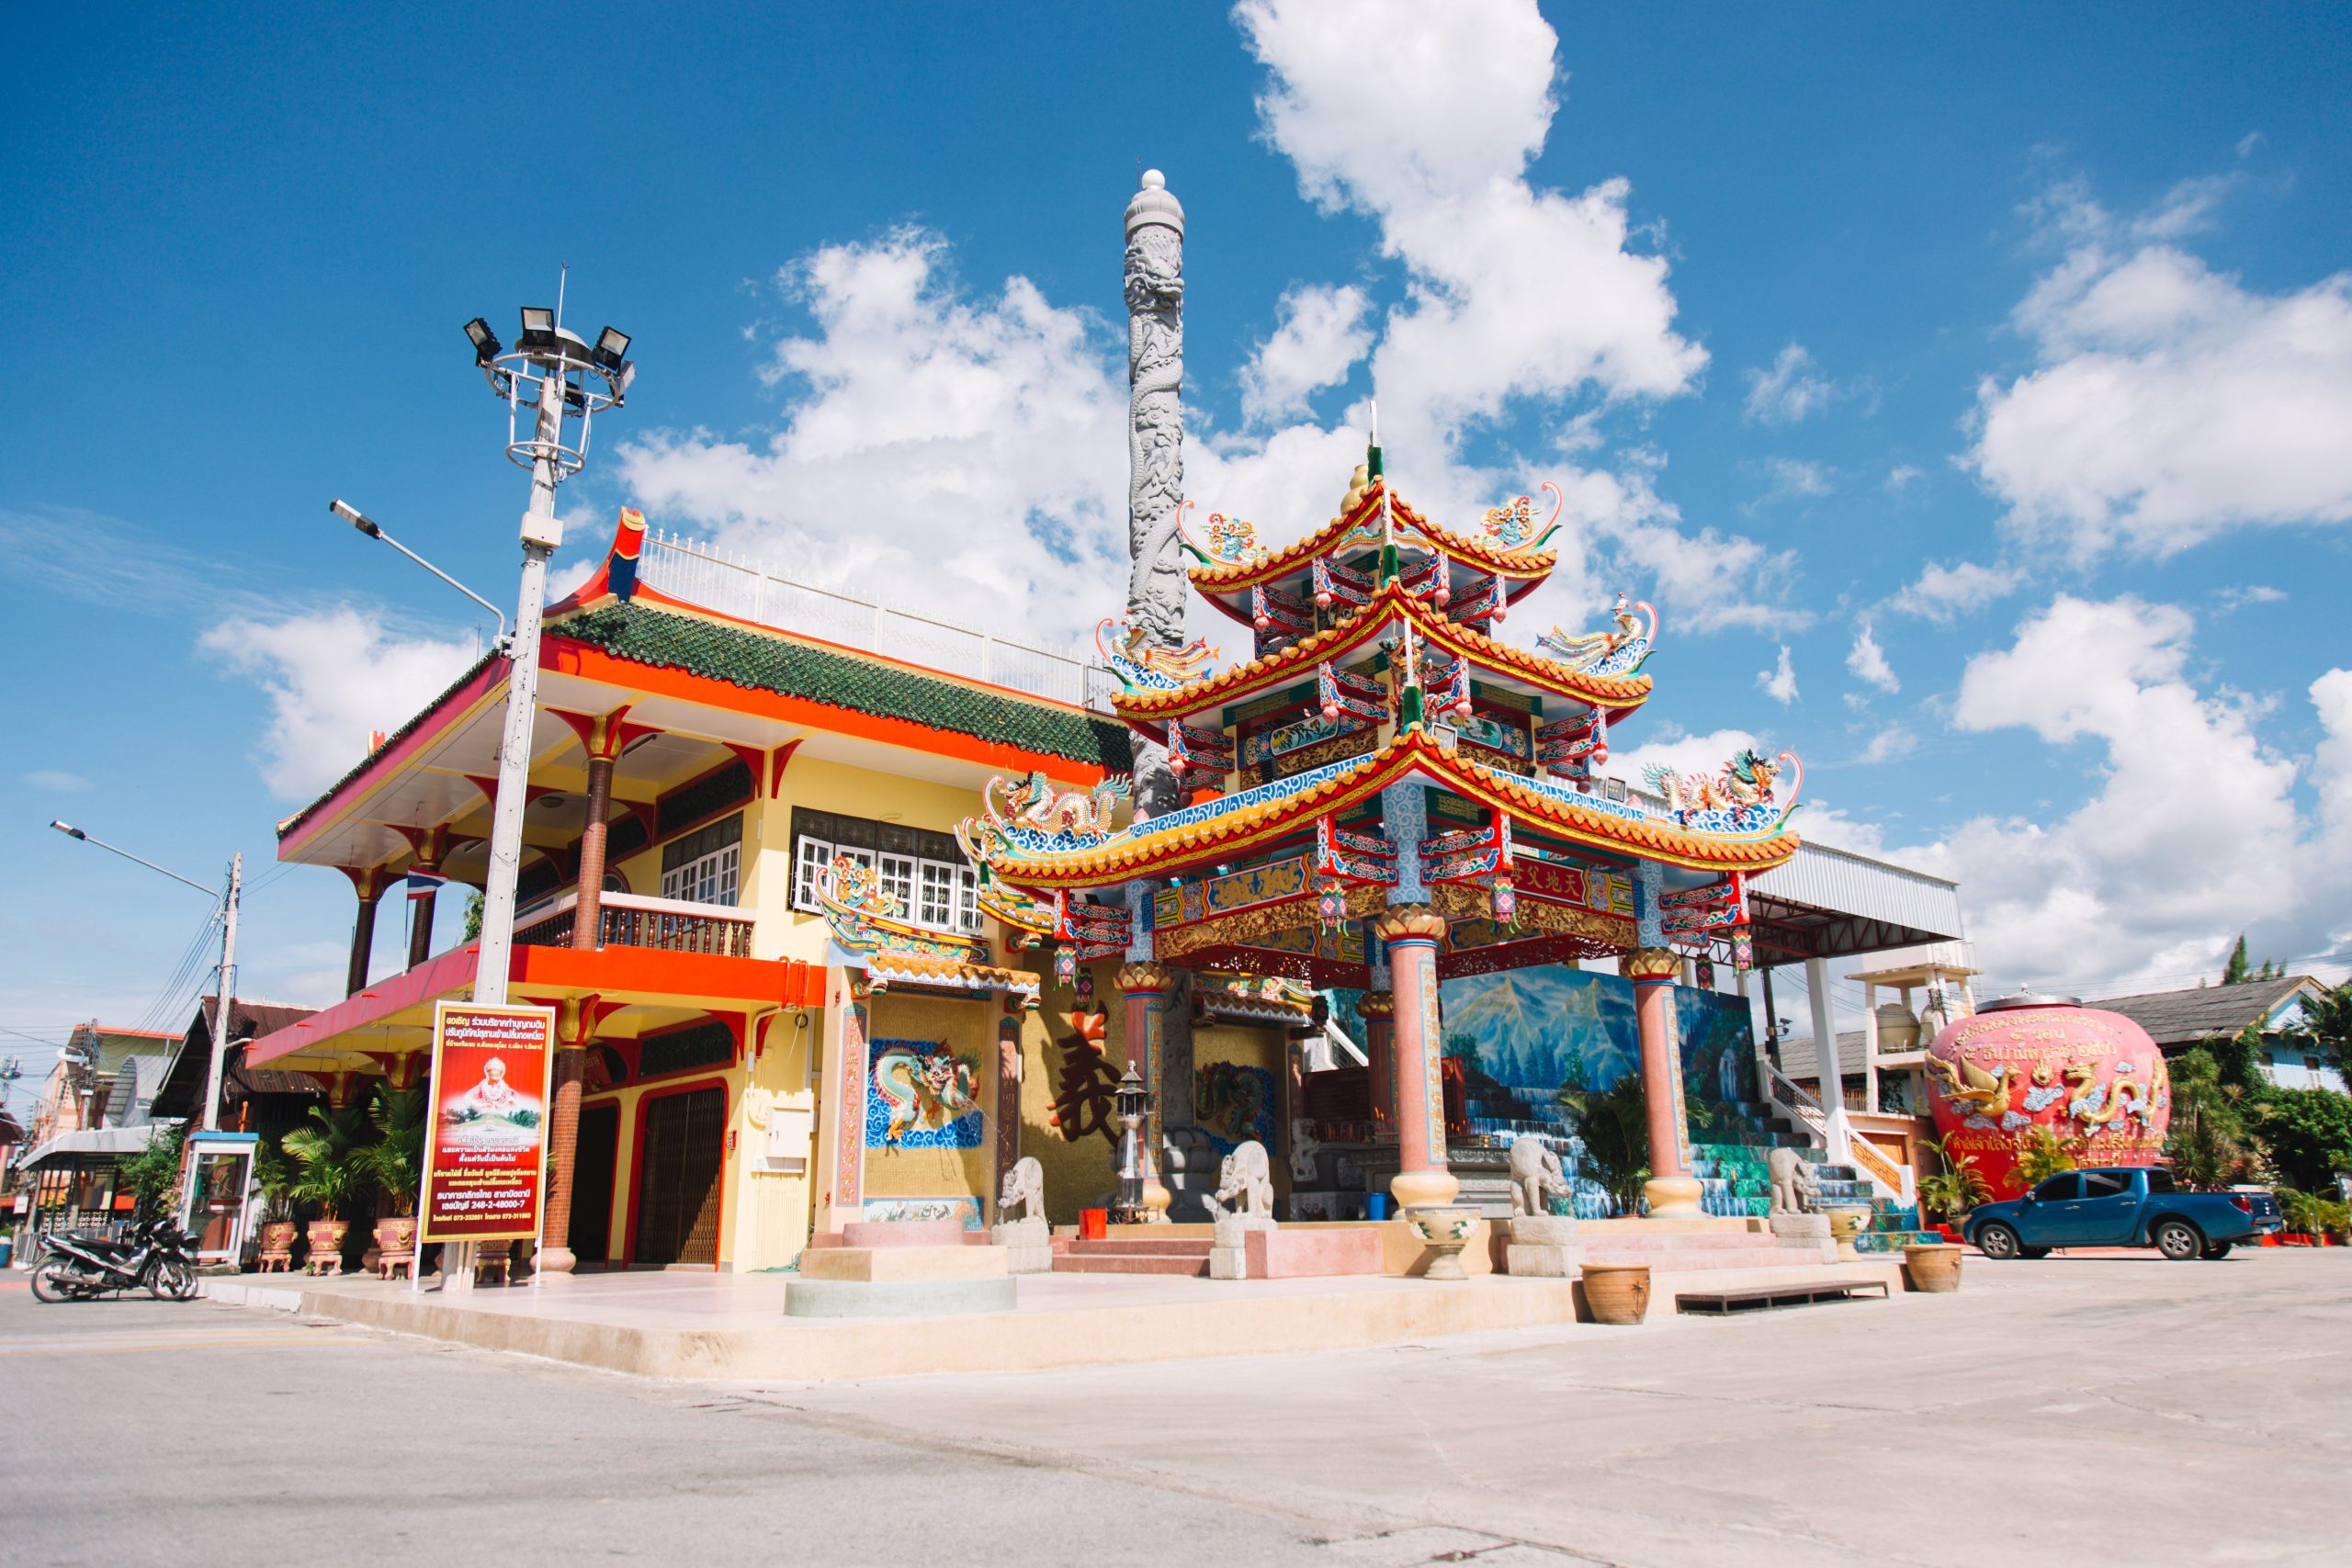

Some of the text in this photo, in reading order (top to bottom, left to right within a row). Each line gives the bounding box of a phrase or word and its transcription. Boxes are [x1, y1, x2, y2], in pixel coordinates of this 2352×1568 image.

[1510, 862, 1580, 897] 天地父母
[446, 1016, 470, 1027] ขอเชิญ
[436, 1189, 531, 1200] ธนาคารกสิกรไทย สาขาปัตตานี
[441, 1201, 469, 1211] เลขบัญชี
